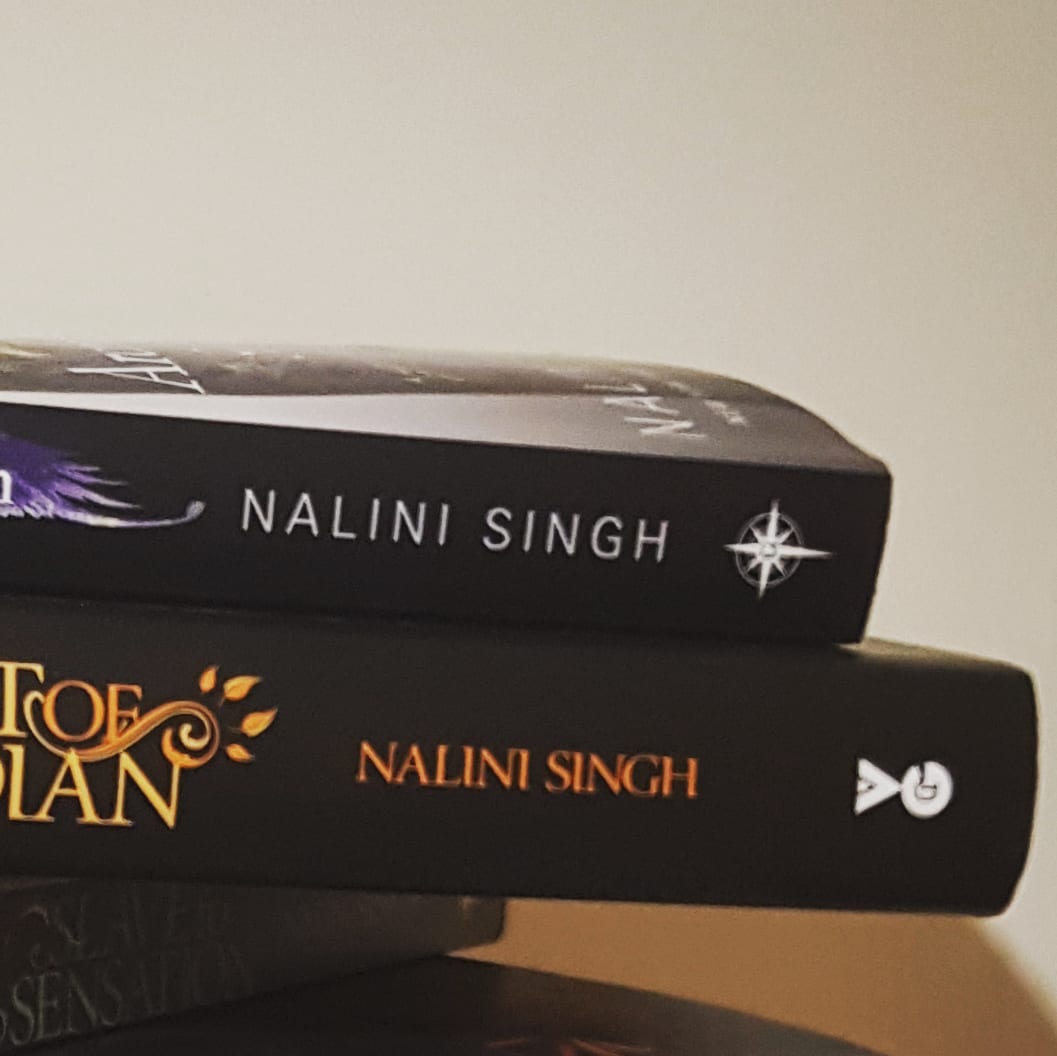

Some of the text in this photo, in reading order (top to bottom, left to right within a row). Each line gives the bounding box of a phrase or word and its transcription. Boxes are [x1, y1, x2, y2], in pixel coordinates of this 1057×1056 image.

[240, 487, 671, 562] NALINI SINGH
[41, 679, 144, 744] OF
[355, 740, 700, 798] NALINI SINGH
